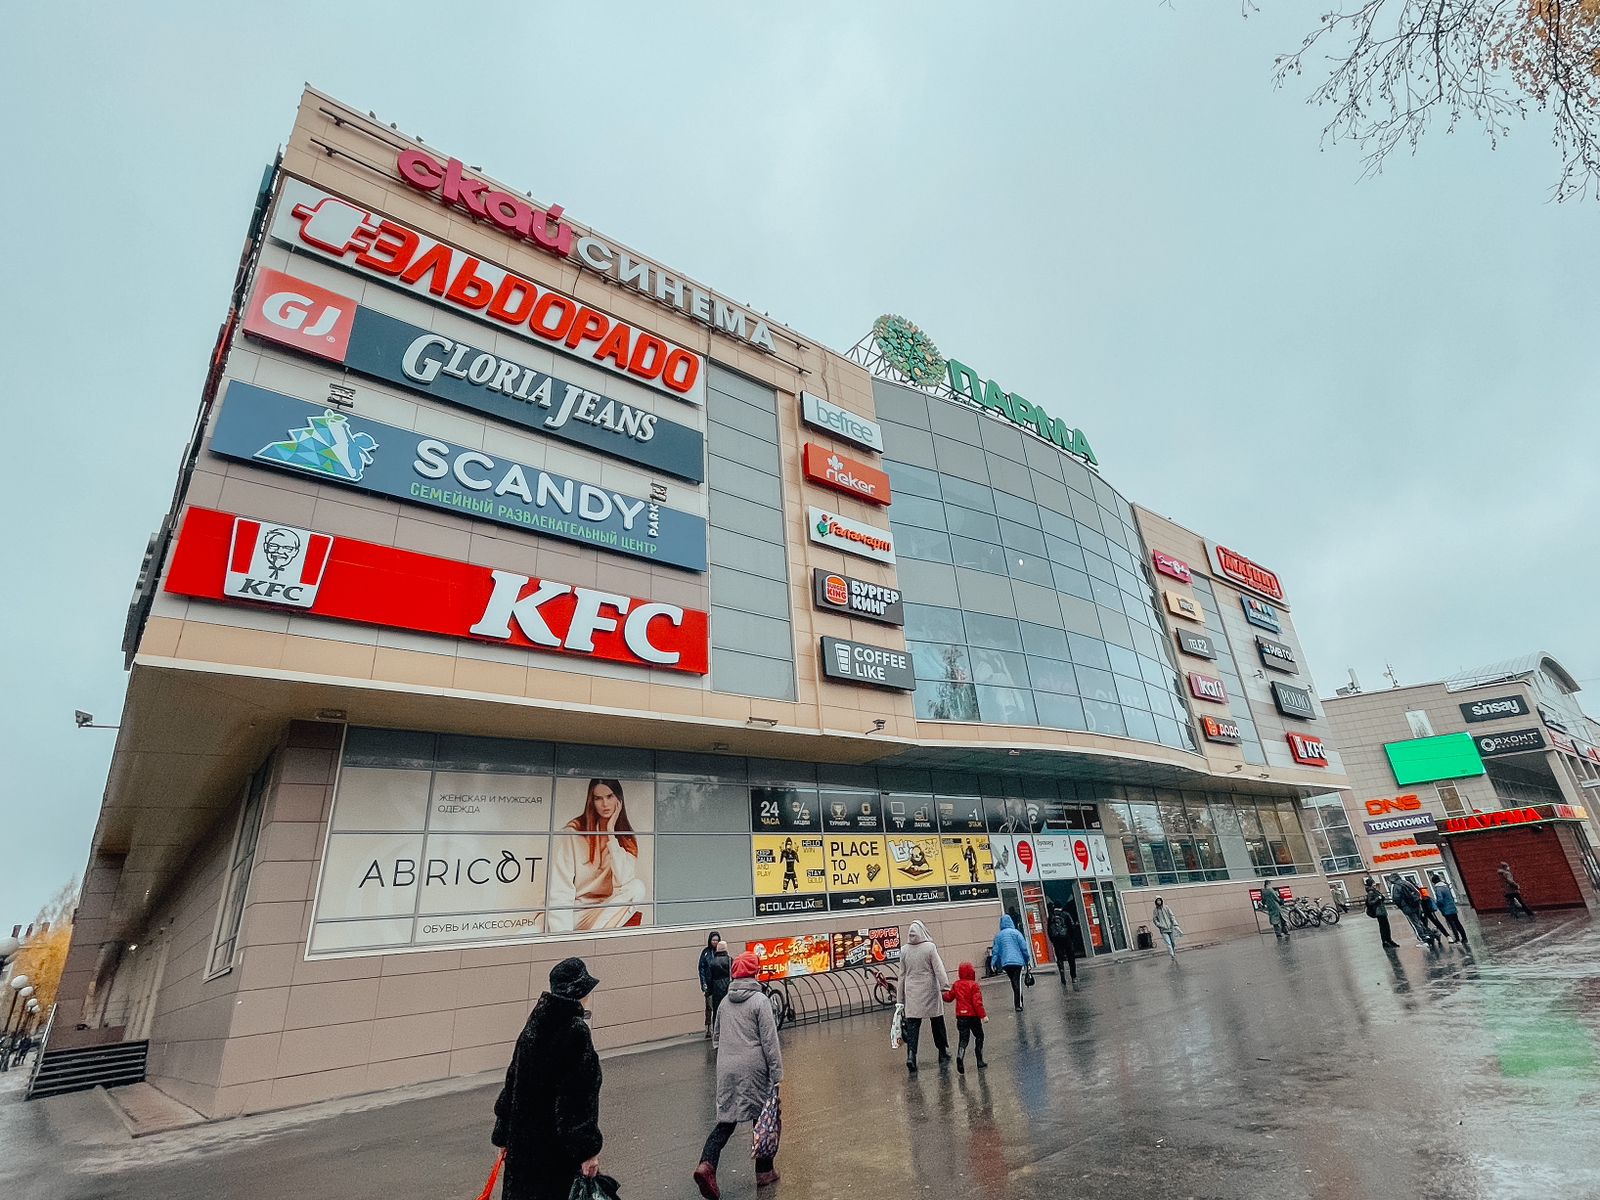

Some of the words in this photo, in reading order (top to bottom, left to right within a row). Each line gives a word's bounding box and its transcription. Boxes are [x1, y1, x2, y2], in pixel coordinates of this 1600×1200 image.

[398, 148, 574, 257] скай
[576, 236, 777, 354] СИНЕМА
[401, 333, 554, 409] GLORIA
[546, 385, 658, 442] JEANS
[816, 399, 873, 443] befree
[948, 358, 1098, 465] ПАРМА
[413, 439, 645, 530] SCANDY
[826, 467, 875, 494] rieker
[410, 482, 494, 514] СЕМЕЙНЫЙ
[498, 505, 618, 547] РАЗВЛЕКАТЕЛЬНЫЙ
[621, 535, 658, 555] ЦЕНТР
[648, 501, 660, 538] PARK
[238, 577, 304, 602] KFC
[827, 588, 847, 600] KING
[851, 580, 900, 605] БУРГЕР
[852, 595, 888, 616] КИНГ
[470, 569, 685, 665] KFC
[1188, 638, 1209, 653] TELE2
[854, 647, 906, 670] COFFEE
[855, 662, 886, 680] LIKE
[1471, 699, 1520, 716] sinsay
[1219, 723, 1240, 738] ДОДО
[1494, 732, 1538, 745] ЯХОНТ
[1304, 740, 1327, 759] KFC
[439, 793, 486, 804] ЖЕНСКАЯ
[488, 795, 496, 804] И
[498, 795, 543, 806] МУЖСКАЯ
[760, 801, 780, 817] 24
[1365, 794, 1422, 815] DNS
[437, 804, 481, 815] ОДЕЖДА
[761, 817, 780, 825] ЧАСА
[1445, 807, 1543, 833] ШАУРМА
[831, 841, 879, 857] PLACE
[358, 850, 543, 888] ABRICOT
[831, 860, 847, 871] TO
[833, 872, 860, 886] PLAY
[422, 924, 459, 935] ОБУВЬ
[461, 923, 470, 932] И
[472, 918, 537, 931] АКСЕССУАРЫ
[869, 927, 898, 939] БУРГЕР
[884, 938, 899, 948] БАР
